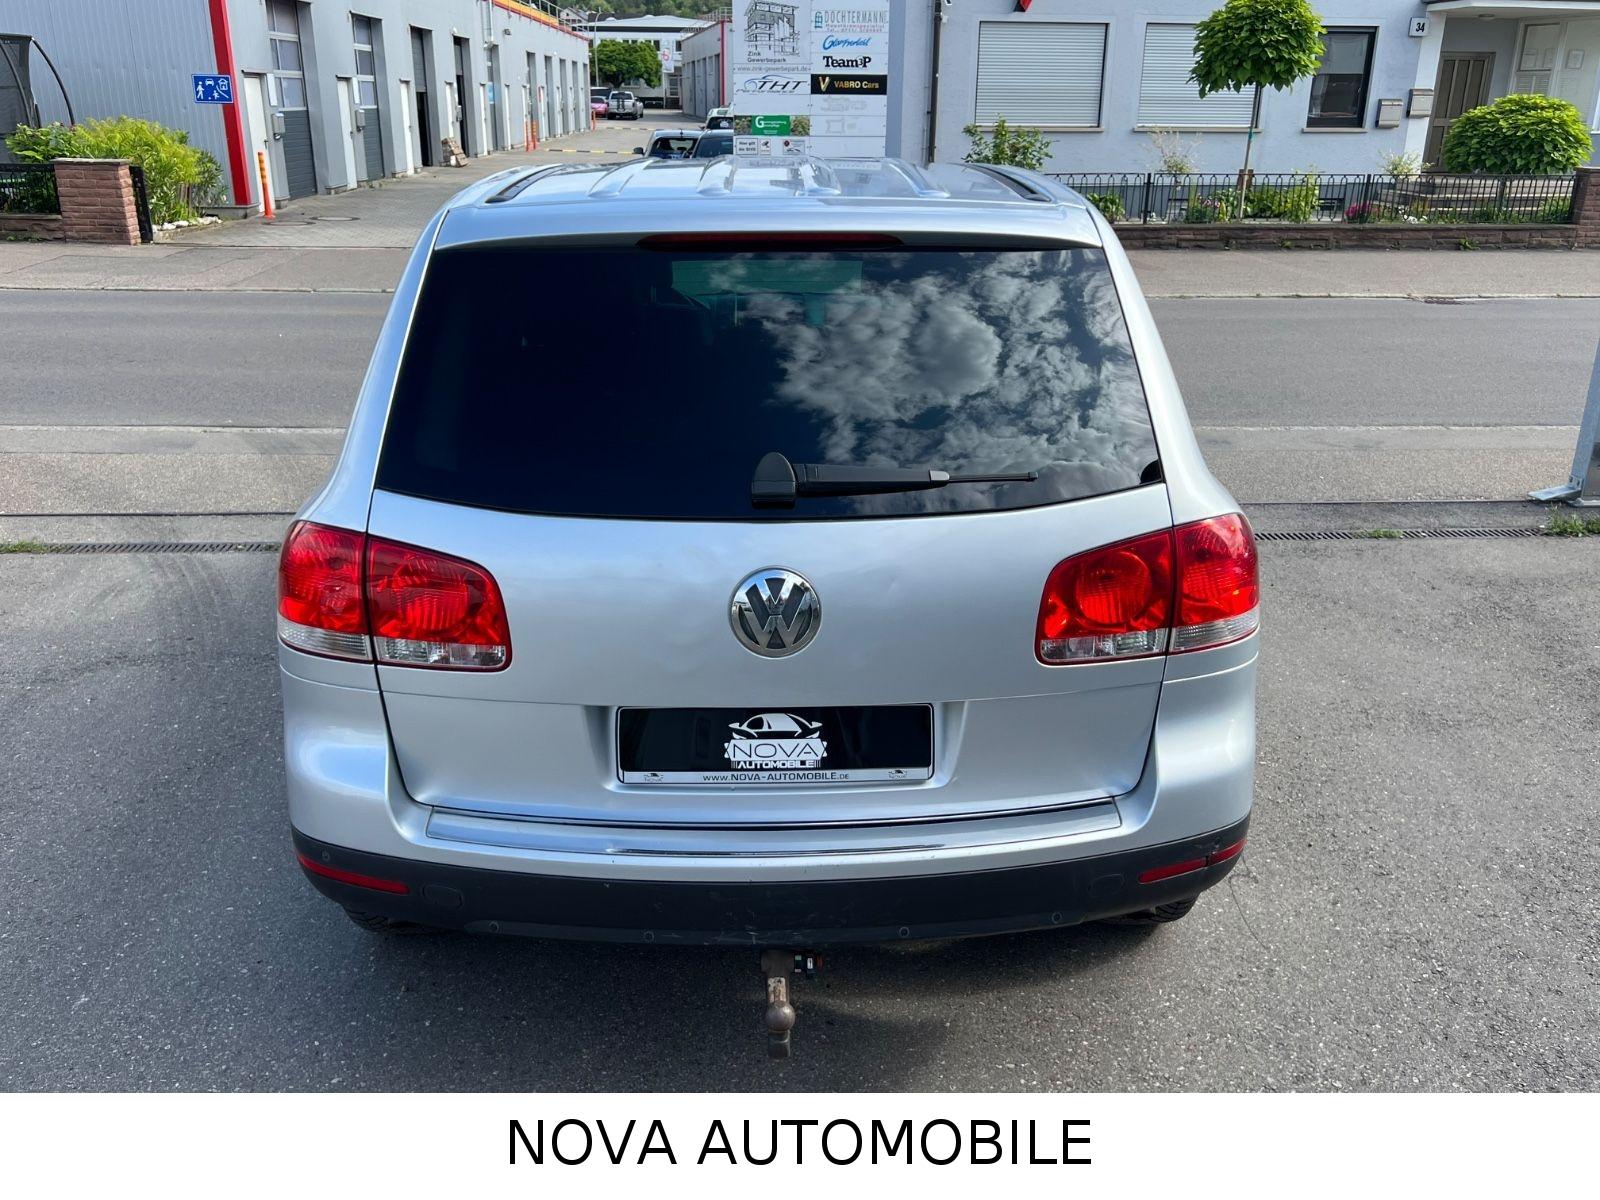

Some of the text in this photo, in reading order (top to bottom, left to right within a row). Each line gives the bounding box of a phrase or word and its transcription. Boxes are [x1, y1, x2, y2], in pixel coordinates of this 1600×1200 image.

[1415, 22, 1425, 32] 34
[758, 80, 807, 90] THT
[834, 81, 880, 89] VABRO Cars
[733, 743, 819, 758] NOVA
[738, 760, 815, 769] AUTOMOBILE
